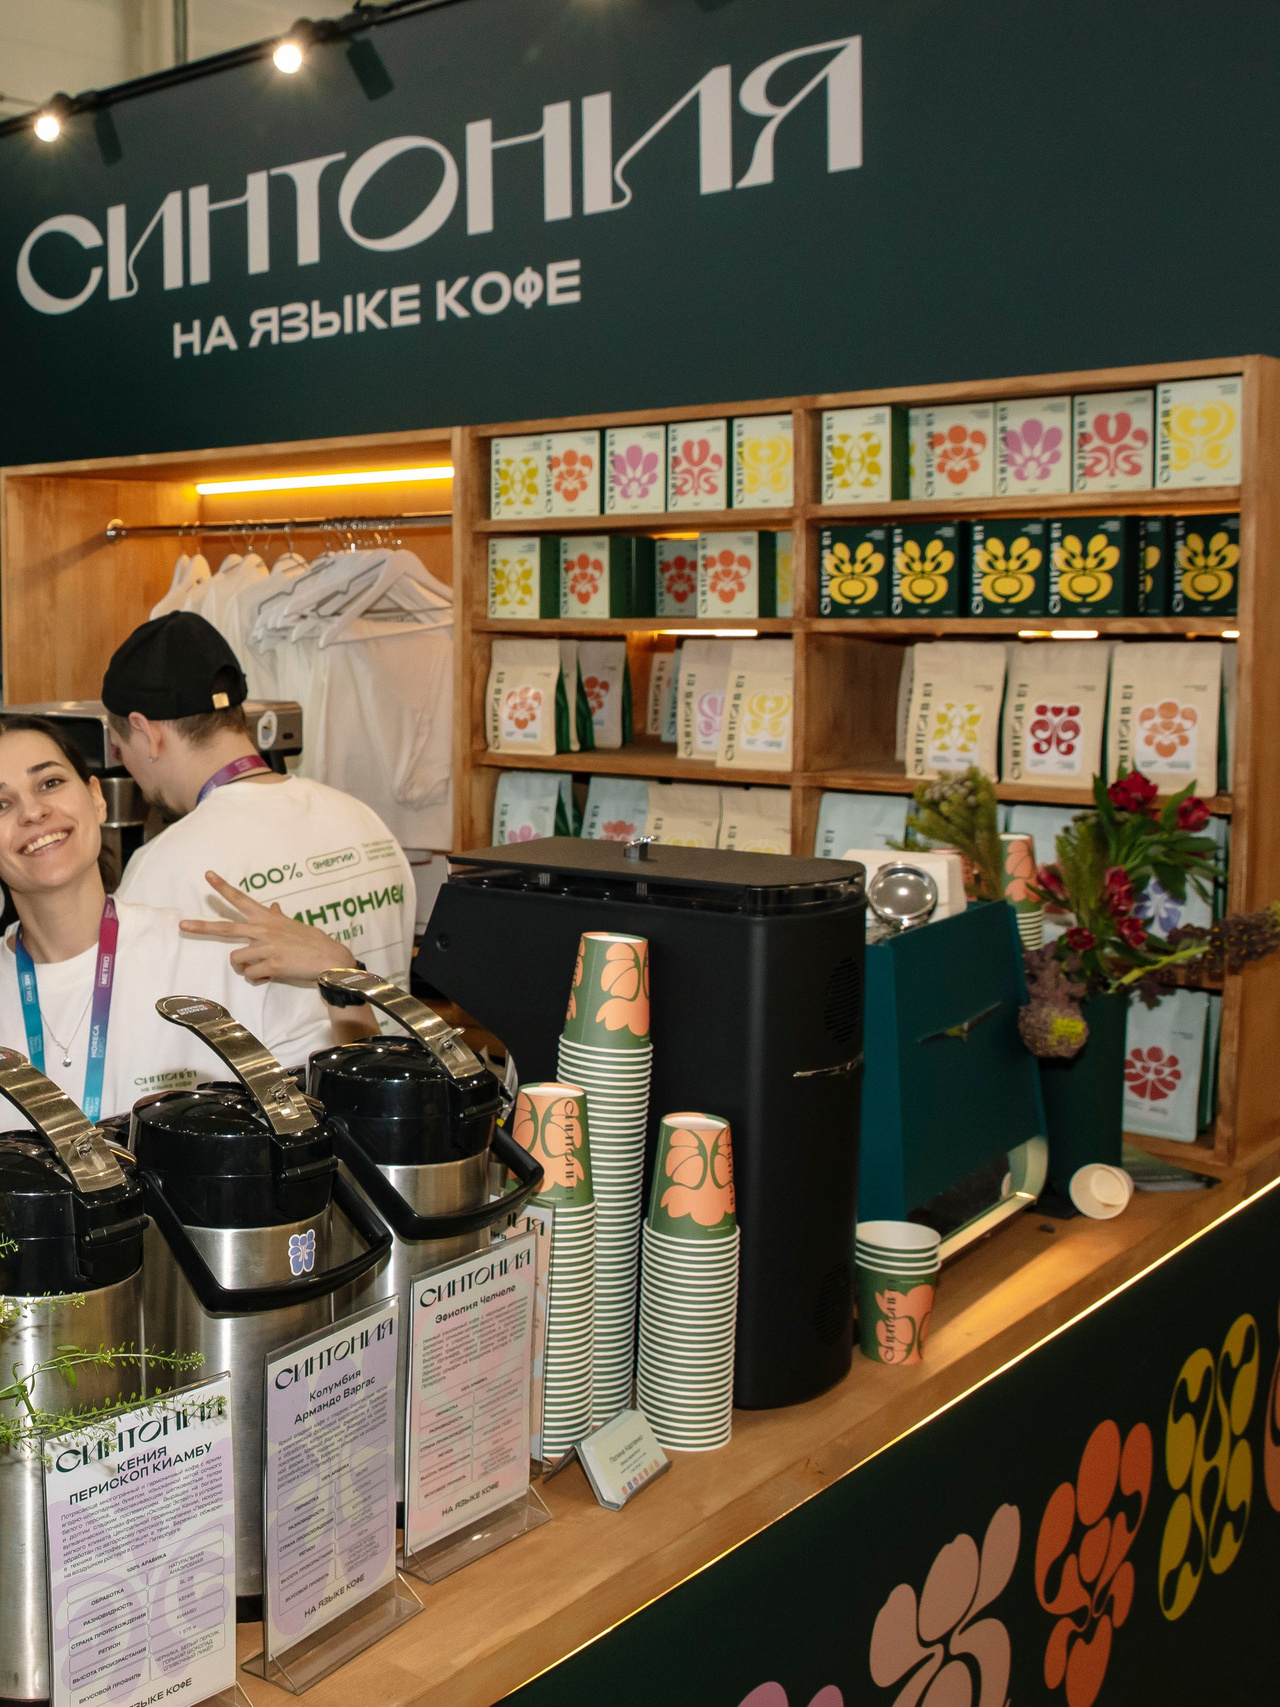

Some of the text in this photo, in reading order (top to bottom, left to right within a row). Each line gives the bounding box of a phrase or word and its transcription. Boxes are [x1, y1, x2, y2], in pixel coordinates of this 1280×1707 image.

[17, 35, 863, 315] СИНТОНИЯ
[174, 259, 580, 358] НА ЯЗЫКЕ КОФЕ
[239, 863, 303, 893] 100%
[100, 955, 111, 985] METRO
[91, 1025, 99, 1058] HORECA
[419, 1247, 530, 1310] СИНТОНИЯ
[435, 1282, 515, 1325] Эфиопия Челчеле
[275, 1317, 392, 1393] СИНТОНИЯ
[294, 1374, 375, 1427] Армандо Варгас
[309, 1367, 360, 1404] Колумбия
[69, 1441, 211, 1505] ПЕРИСКОП КИАМБУ
[117, 1445, 166, 1473] КЕНИЯ
[141, 1552, 166, 1567] АРАБИКА
[83, 1600, 132, 1626] РАЗНОВИДНОСТЬ
[90, 1587, 124, 1606] ОБРАБОТКА
[304, 1573, 364, 1618] НА ЯЗЫКЕ КОФЕ
[71, 1611, 146, 1650] СТРАНА ПРОИСХОЖДЕНИЯ
[98, 1641, 120, 1655] РЕГИОН
[72, 1646, 146, 1684] ВЫСОТА ПРОИЗРАСТАНИЯ
[79, 1671, 141, 1704] ВКУСОВОЙ ПРОФИЛЬ
[166, 1677, 192, 1696] КОФЕ
